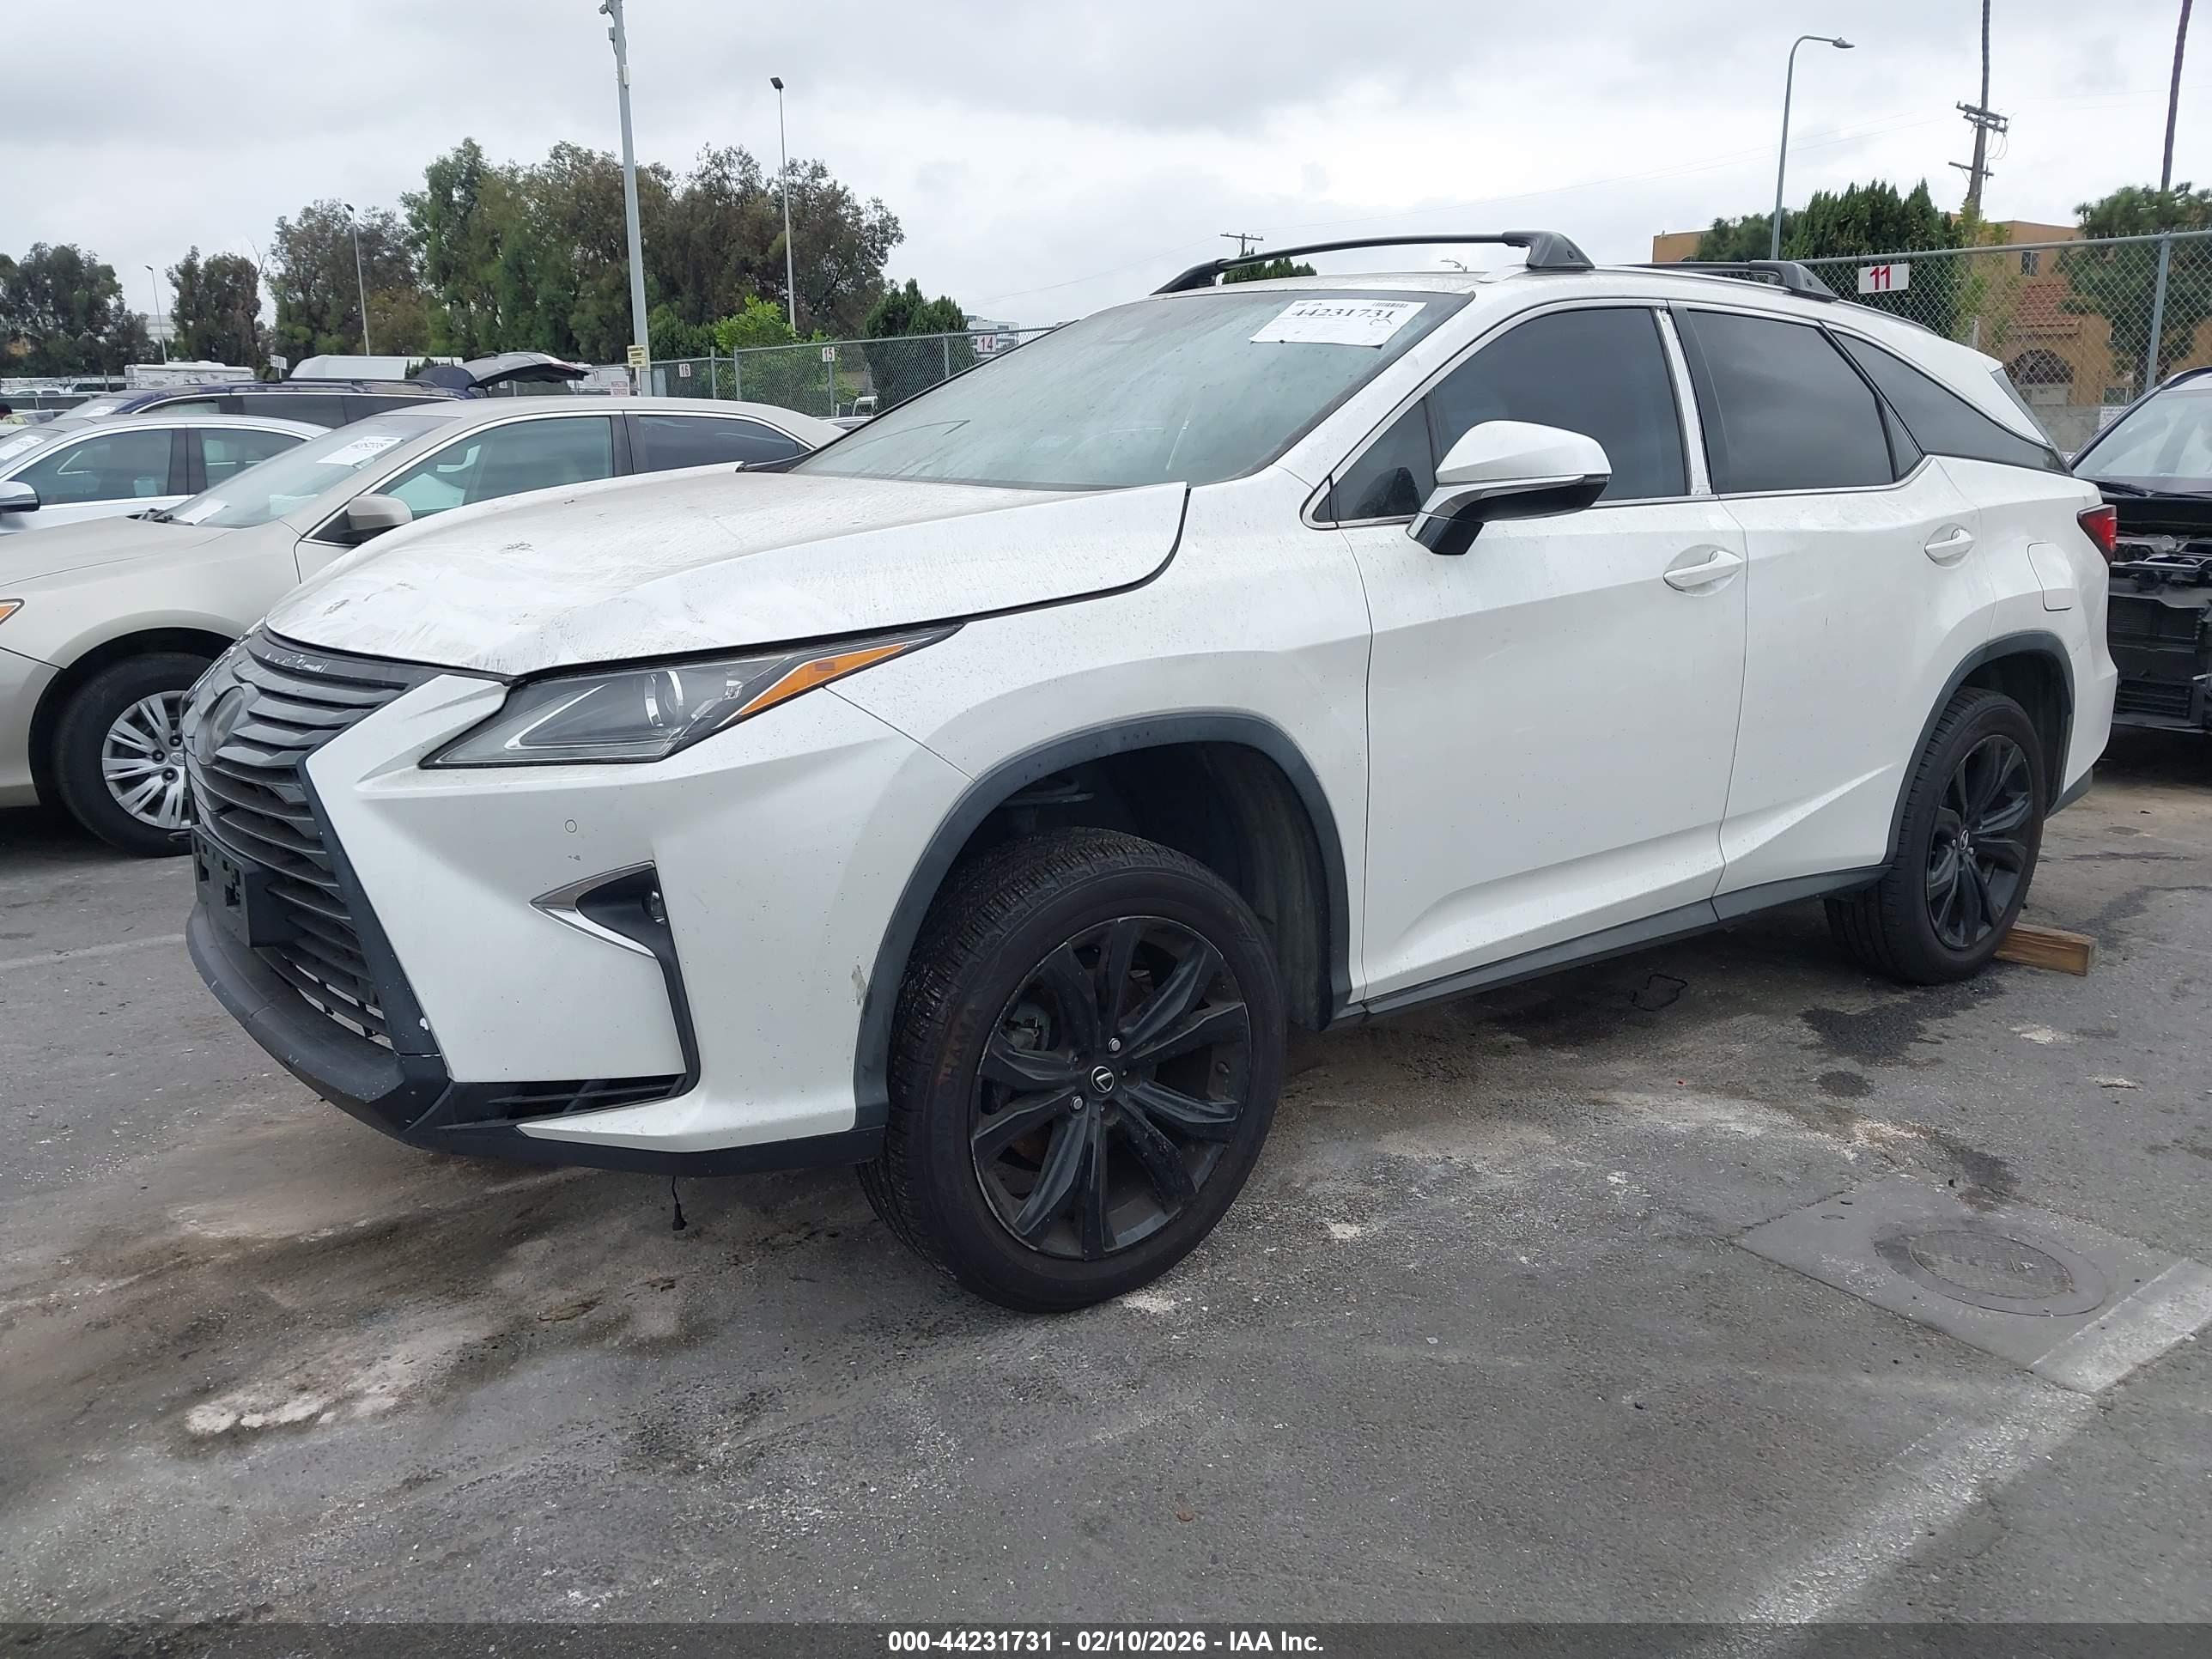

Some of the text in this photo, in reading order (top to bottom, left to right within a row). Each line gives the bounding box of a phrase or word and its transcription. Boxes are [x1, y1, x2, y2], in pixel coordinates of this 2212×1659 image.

[1869, 265, 1891, 290] 11
[1291, 308, 1395, 319] 44231731
[981, 336, 994, 351] 14
[823, 348, 833, 361] 15
[681, 364, 690, 376] 16
